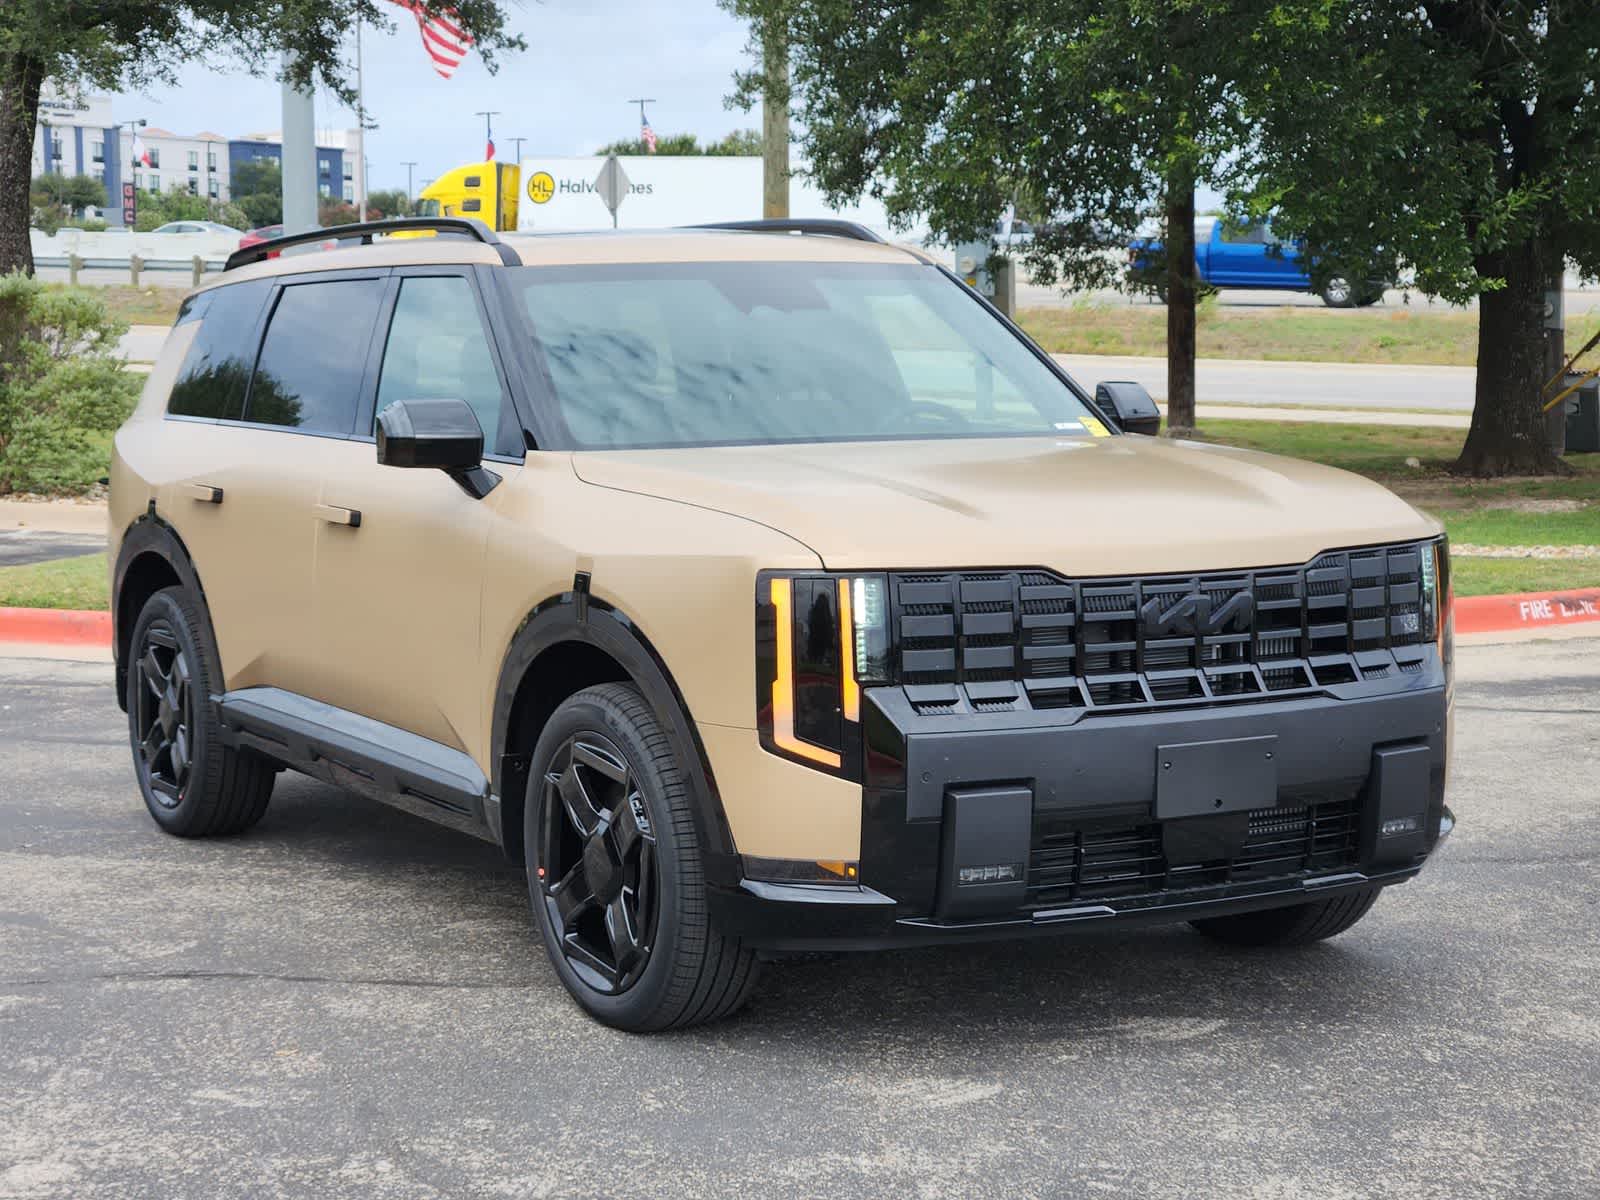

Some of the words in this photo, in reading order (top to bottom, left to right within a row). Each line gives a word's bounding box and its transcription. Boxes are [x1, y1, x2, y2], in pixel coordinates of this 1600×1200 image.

[532, 180, 553, 192] HL
[559, 179, 601, 194] Halv
[124, 185, 134, 222] GMC
[1141, 591, 1252, 635] KIA
[1519, 599, 1555, 621] FIRE
